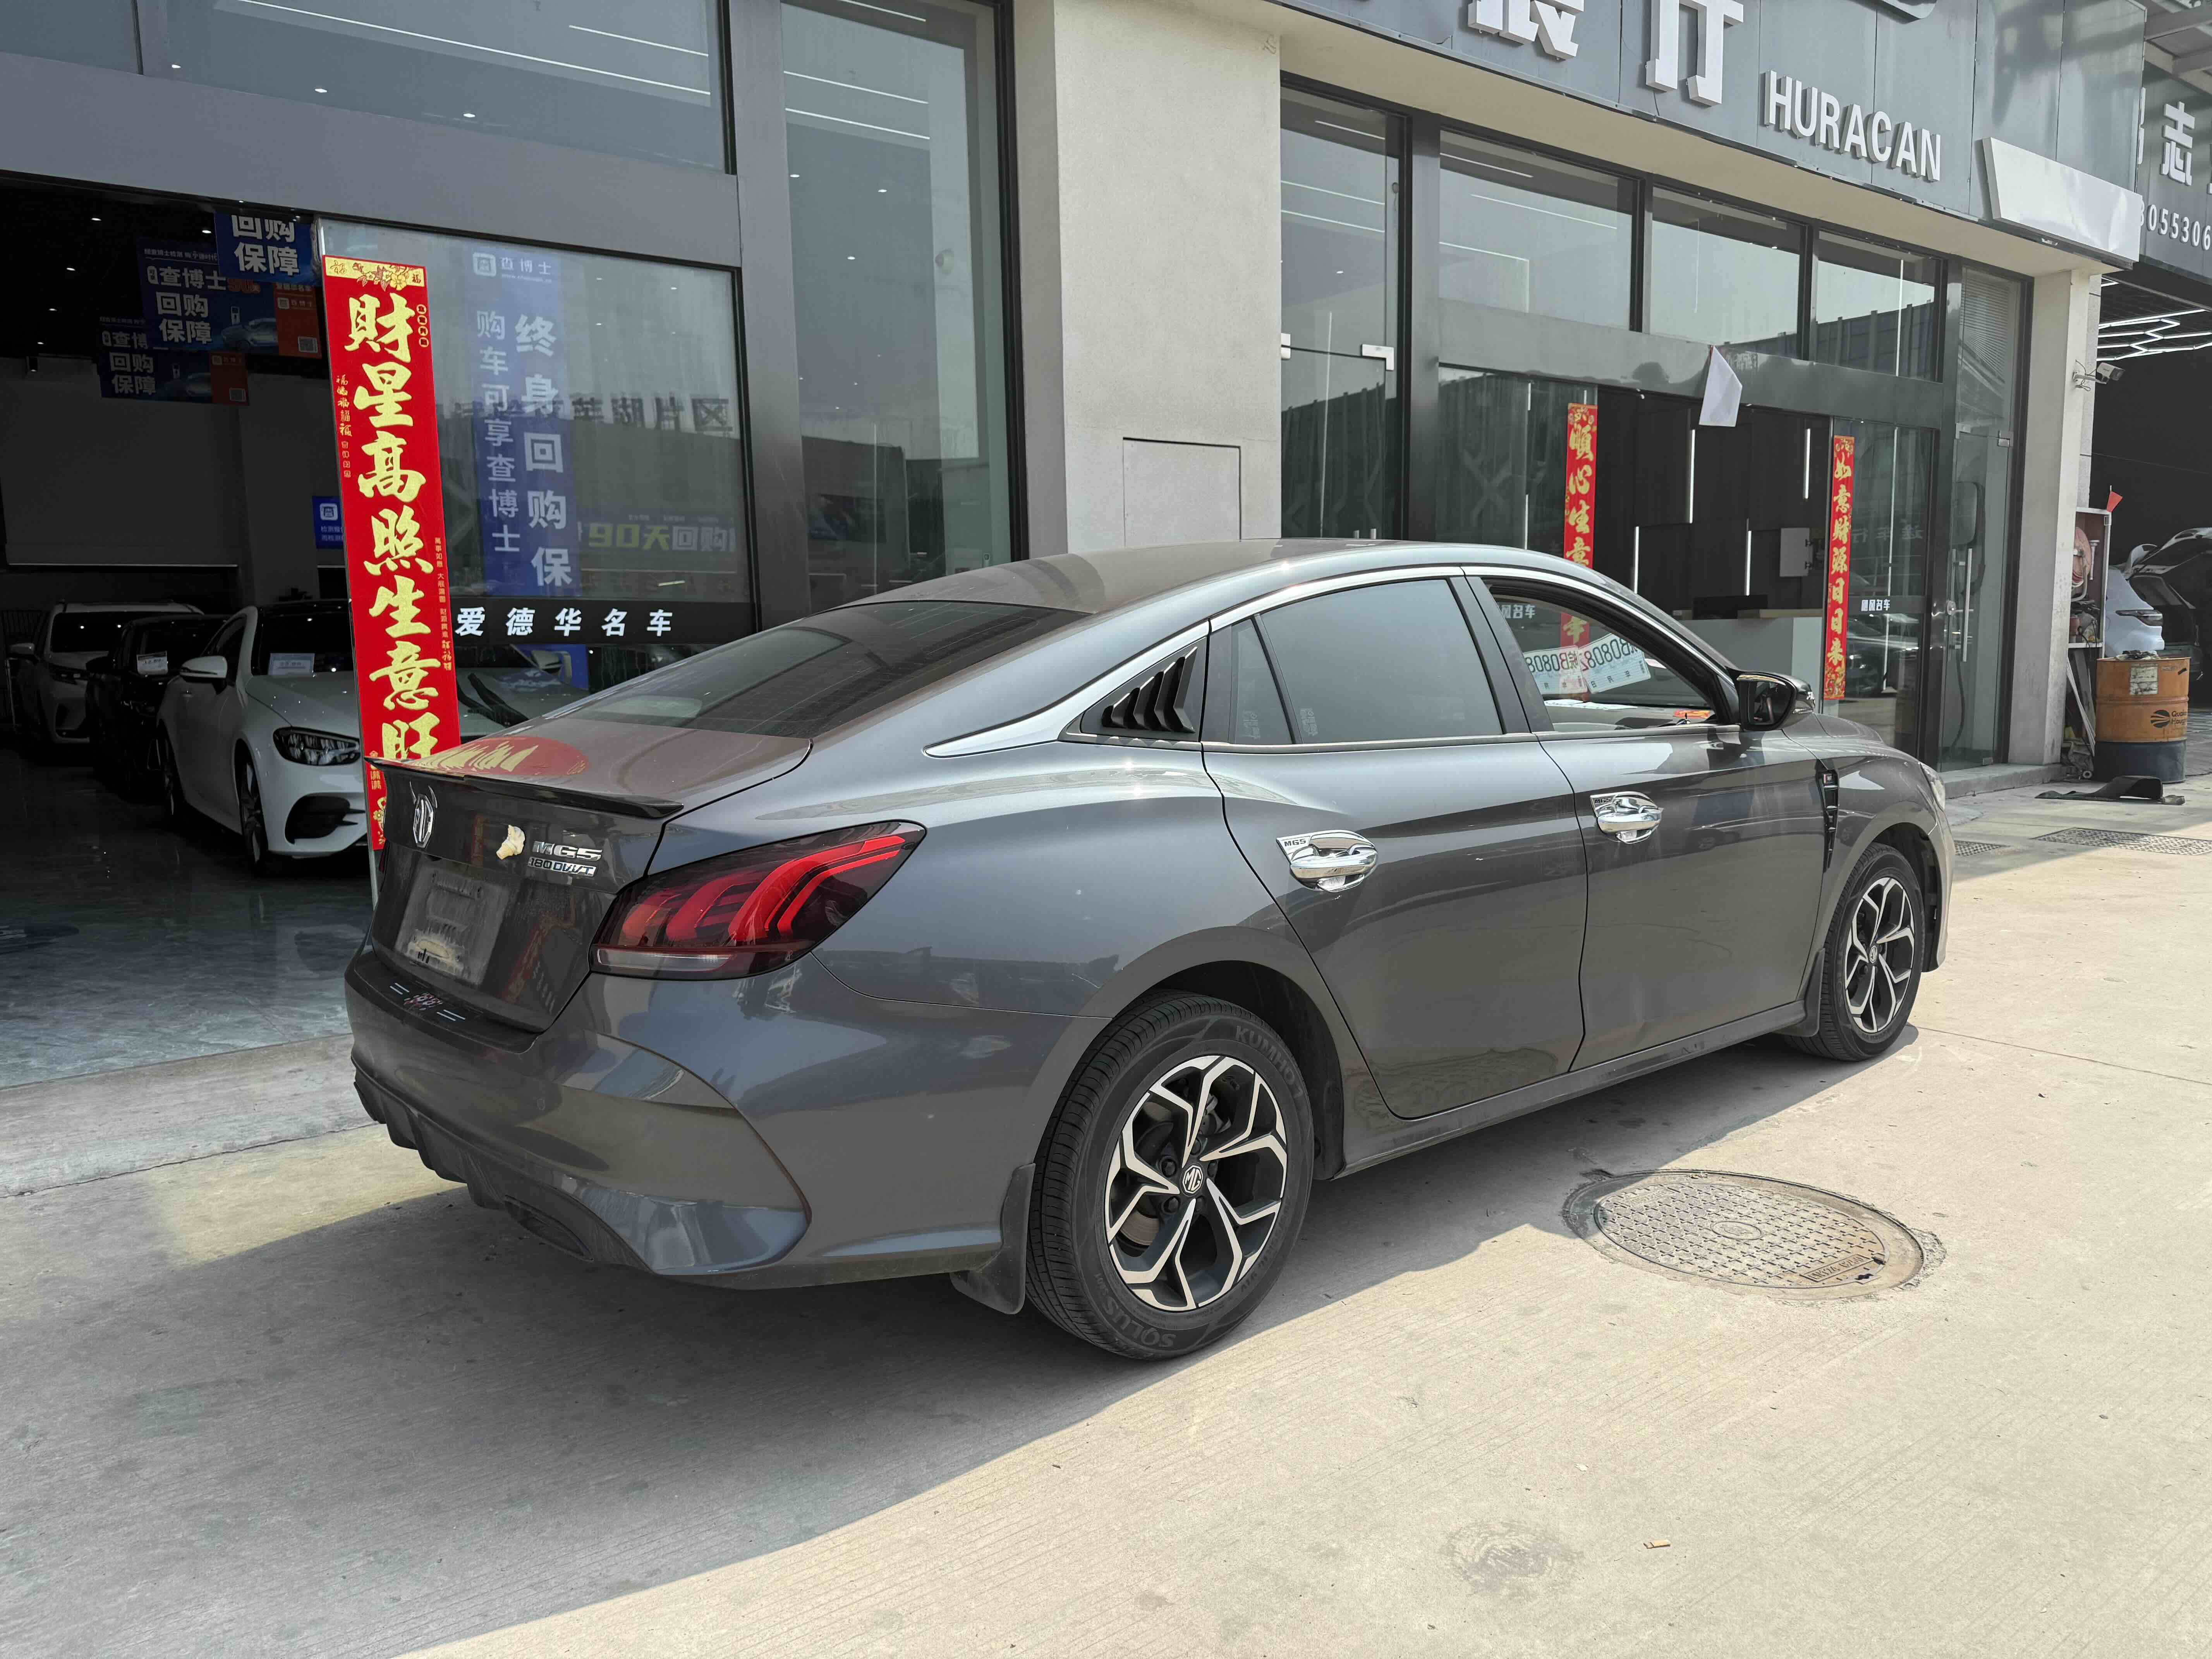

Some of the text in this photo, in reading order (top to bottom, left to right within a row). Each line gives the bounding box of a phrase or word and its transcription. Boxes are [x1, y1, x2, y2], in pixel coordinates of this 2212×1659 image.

[1764, 70, 1941, 182] HURACAN
[231, 214, 295, 242] 回购
[234, 242, 300, 276] 保障
[159, 266, 227, 291] 查博士
[156, 291, 209, 318] 回购
[159, 319, 212, 345] 保障
[109, 352, 154, 373] 回购
[112, 374, 156, 395] 保障
[477, 309, 520, 553] 购车可享查博士
[515, 314, 573, 587] 终身回购保
[455, 606, 673, 637] 爱德华名车
[532, 841, 603, 861] MG5
[1284, 839, 1306, 847] MG5
[1183, 1166, 1202, 1192] MG
[1103, 1296, 1177, 1348] SOLUS
